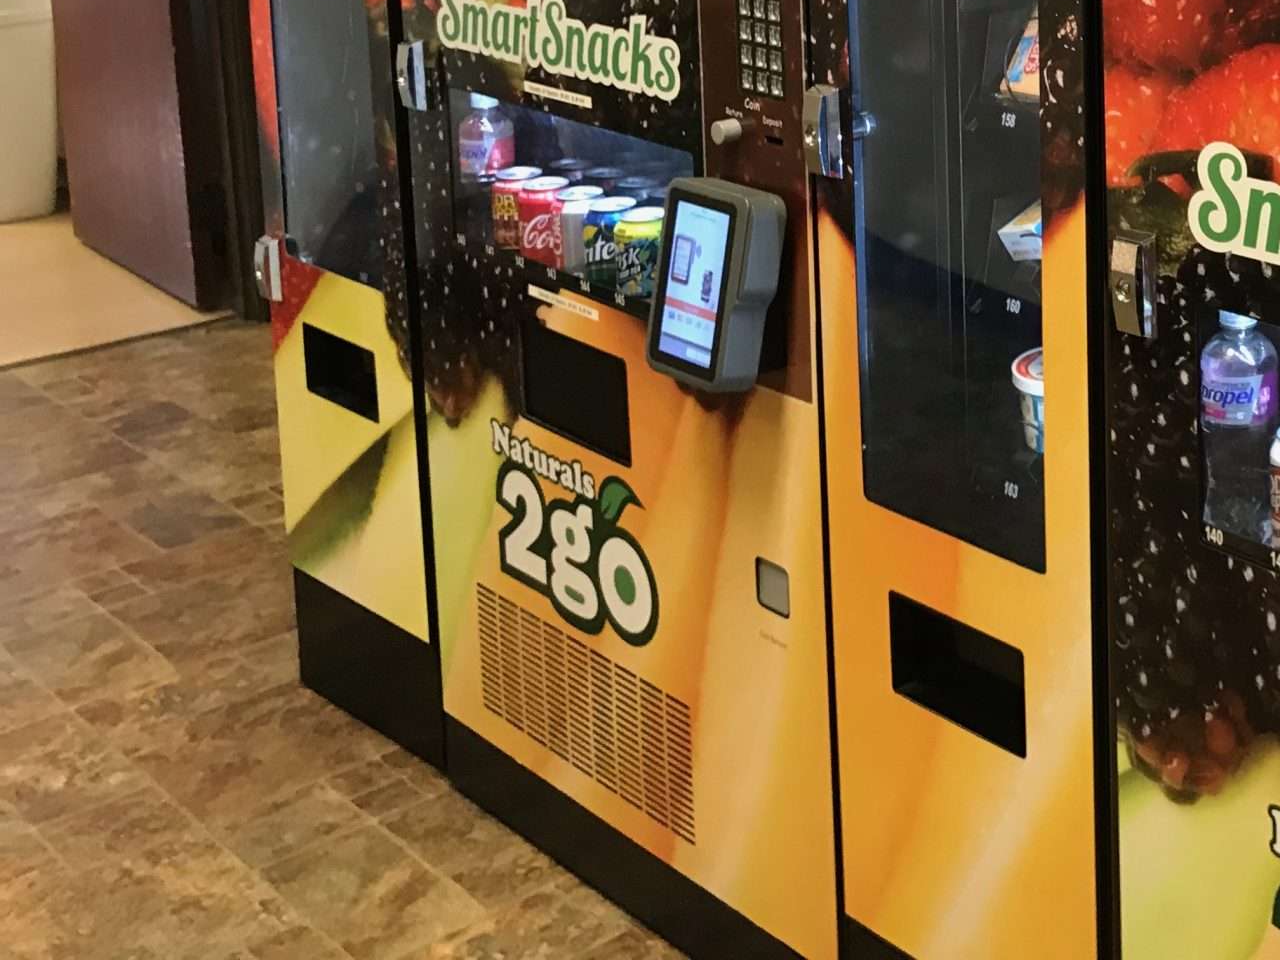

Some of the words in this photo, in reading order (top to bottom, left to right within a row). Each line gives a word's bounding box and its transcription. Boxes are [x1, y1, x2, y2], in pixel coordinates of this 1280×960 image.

[744, 97, 761, 111] Coin
[1001, 112, 1016, 128] 158
[1005, 298, 1020, 315] 160
[1201, 384, 1254, 406] propel
[490, 417, 596, 501] Naturals
[1205, 525, 1224, 546] 140
[501, 468, 653, 635] 2go
